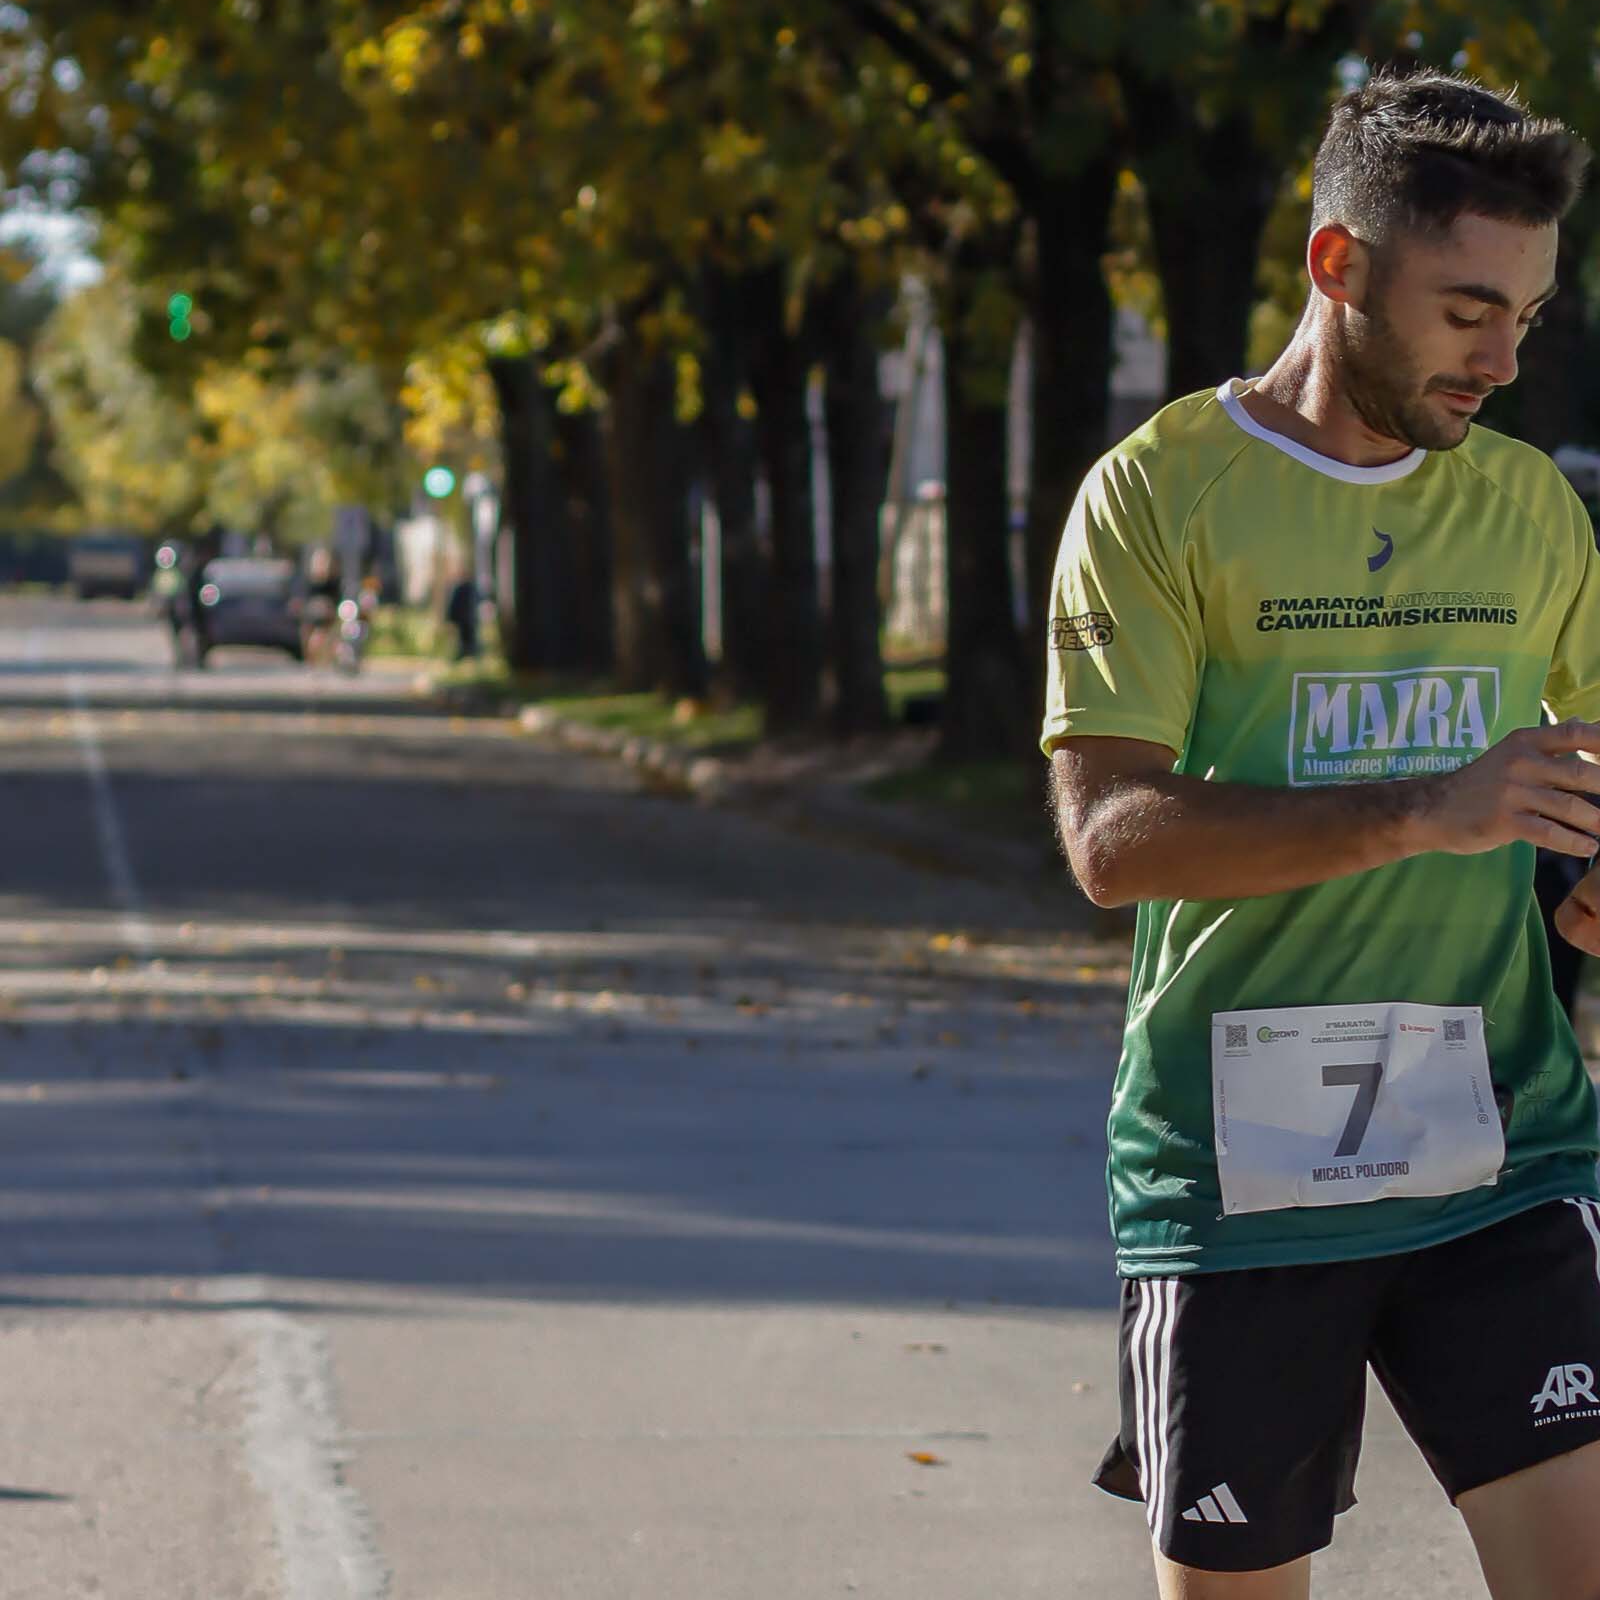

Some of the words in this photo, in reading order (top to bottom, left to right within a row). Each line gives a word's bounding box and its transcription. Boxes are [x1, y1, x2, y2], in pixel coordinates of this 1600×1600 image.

[1385, 591, 1516, 608] ANIVERSARIO
[1256, 607, 1518, 632] CAWILLIAMSKEMMIS
[1303, 677, 1488, 753] MAIRA
[1303, 757, 1383, 776] Almacenes
[1386, 753, 1462, 773] Mayoristas
[1321, 1062, 1383, 1157] 7
[1312, 1166, 1354, 1182] MICAEL
[1356, 1161, 1409, 1178] POLIDORO
[1530, 1363, 1600, 1413] AR
[1534, 1414, 1561, 1427] ADIDAS
